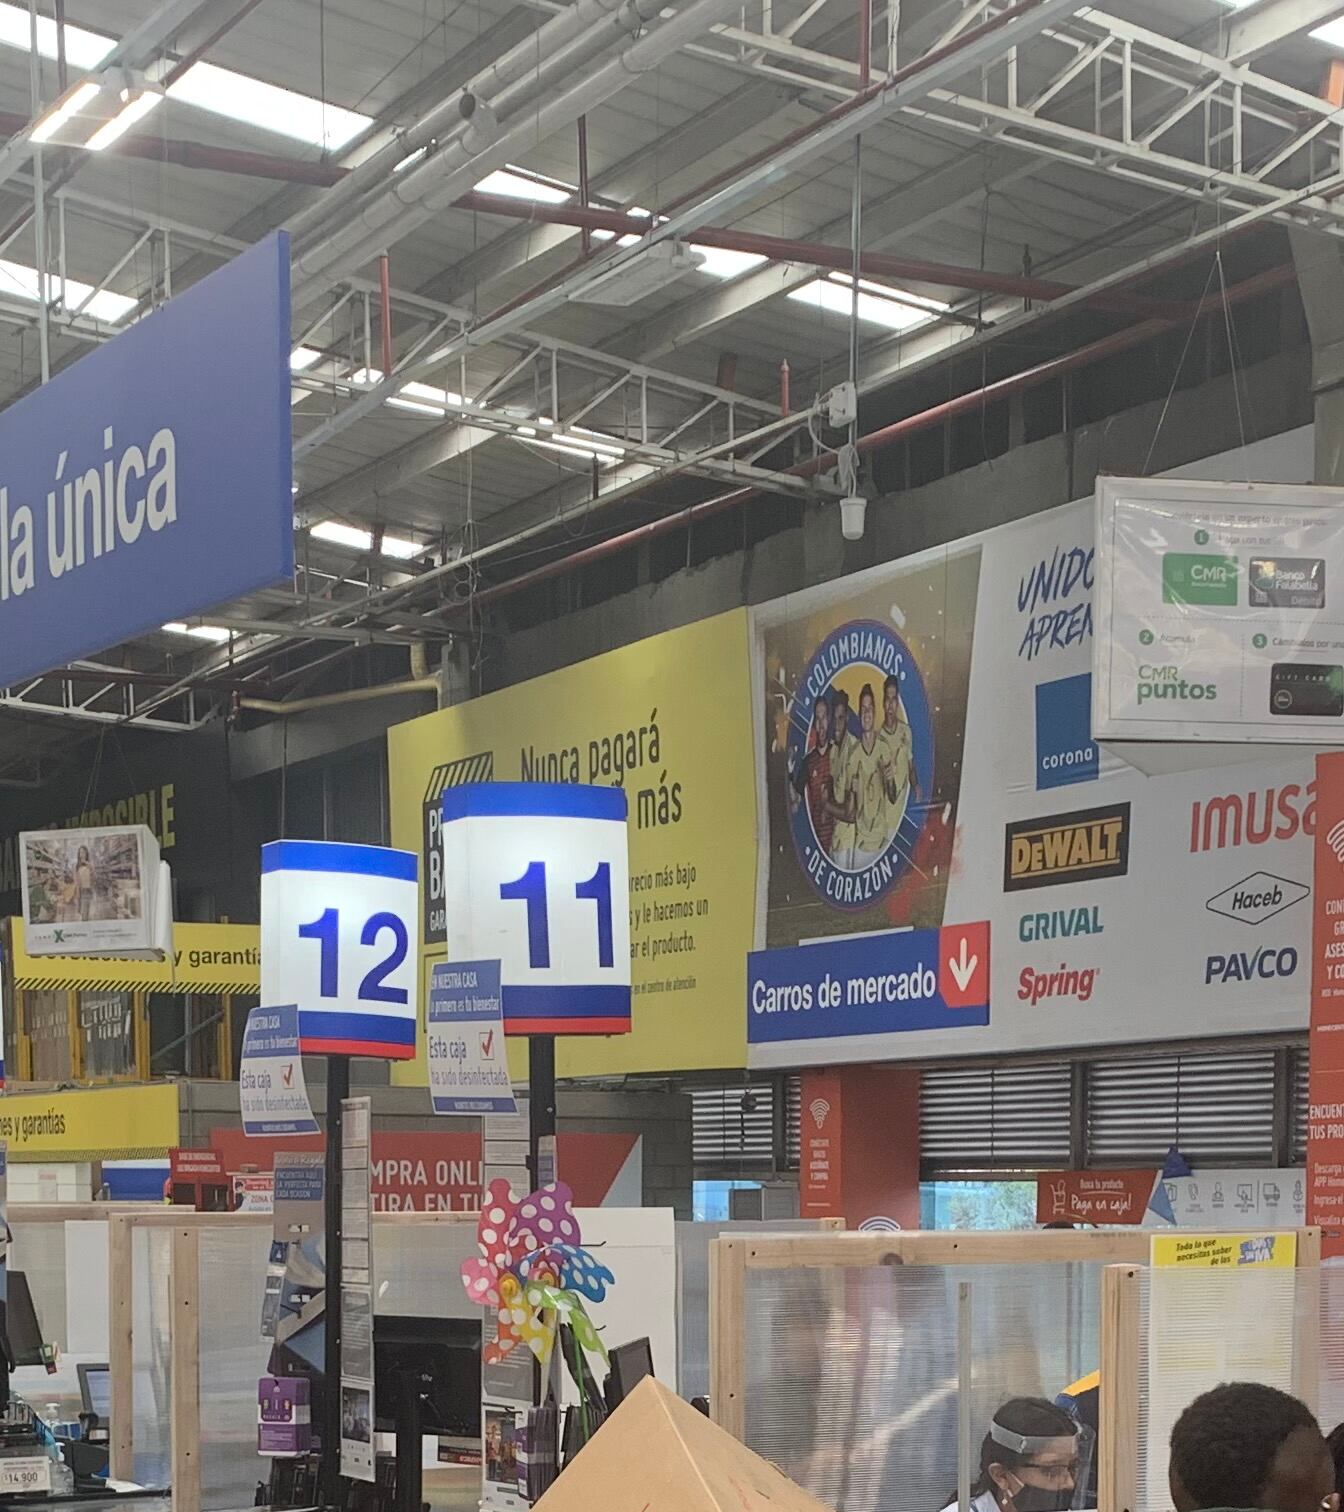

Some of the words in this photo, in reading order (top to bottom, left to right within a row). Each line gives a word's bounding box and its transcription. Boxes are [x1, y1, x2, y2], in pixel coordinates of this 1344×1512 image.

[47, 426, 177, 578] única
[1191, 563, 1226, 582] CMR
[808, 632, 903, 697] COLOMBIANOS
[1138, 664, 1178, 681] CMR
[1137, 680, 1217, 705] puntos
[521, 746, 579, 784] Nunca
[589, 707, 660, 787] pagará
[1043, 747, 1093, 769] corona
[637, 769, 682, 829] más
[655, 865, 673, 888] más
[676, 862, 696, 890] bajo
[808, 852, 823, 885] DE
[826, 859, 893, 902] CORAZÓN
[642, 902, 651, 923] le
[653, 900, 694, 921] hacemos
[696, 898, 709, 916] un
[1232, 886, 1283, 912] Haceb
[499, 862, 614, 968] 11
[1020, 906, 1104, 942] GRIVAL
[173, 948, 182, 968] y
[298, 908, 410, 1005] 12
[642, 935, 650, 957] el
[652, 929, 696, 961] producto.
[1205, 946, 1298, 984] PAVCO
[1327, 964, 1333, 980] Y
[752, 974, 813, 1014] Carros
[817, 972, 843, 1009] de
[846, 962, 936, 1007] mercado
[1018, 964, 1096, 1006] Spring
[429, 1037, 447, 1060] Esta
[449, 1036, 467, 1064] caja
[242, 1070, 256, 1090] Esta
[257, 1070, 271, 1094] caja
[441, 1068, 457, 1086] sido
[459, 1067, 509, 1087] desinfectada
[22, 1109, 65, 1139] garantías
[1309, 1125, 1325, 1139] TUS
[1071, 1193, 1093, 1215] Paga
[1095, 1199, 1107, 1210] en
[1110, 1192, 1132, 1216] caja!
